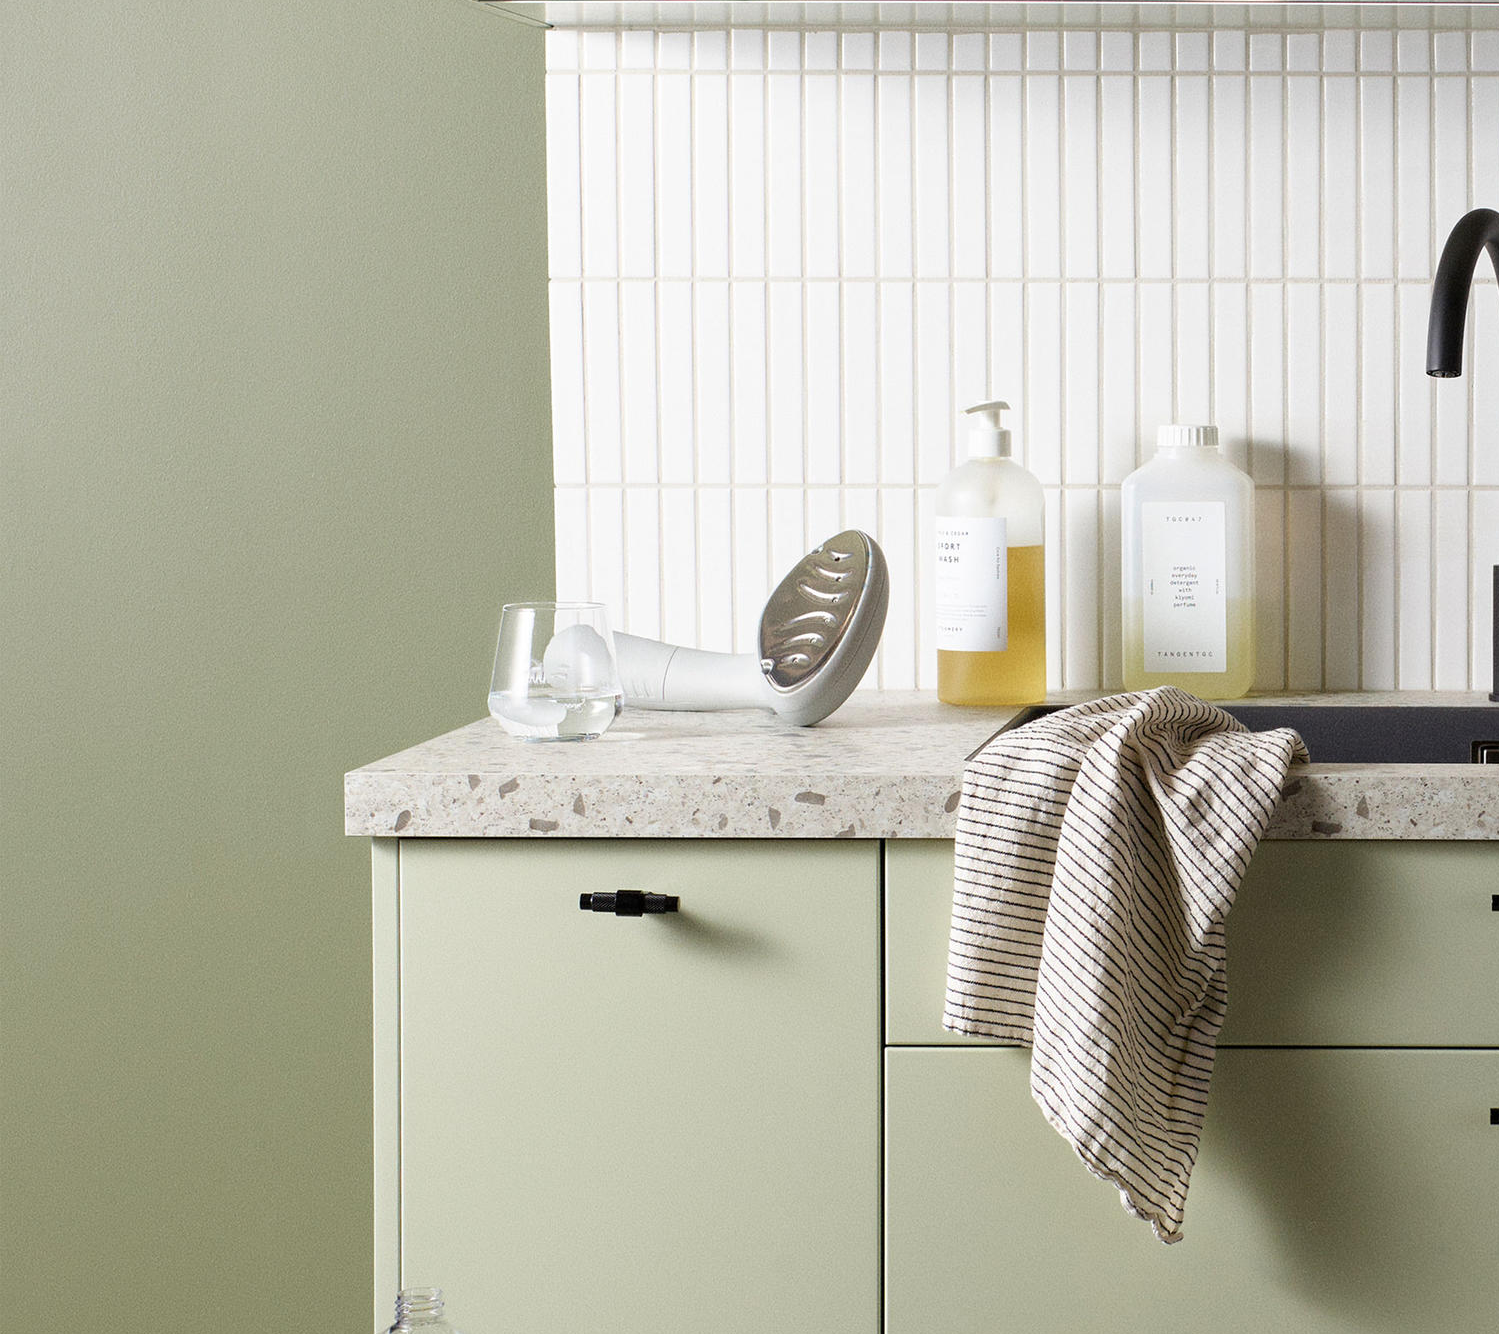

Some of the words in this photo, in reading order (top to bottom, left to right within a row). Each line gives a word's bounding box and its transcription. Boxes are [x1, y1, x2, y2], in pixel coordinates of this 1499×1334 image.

[1172, 565, 1197, 573] organic
[1170, 572, 1198, 580] everyday
[1169, 579, 1200, 588] detergent
[1172, 601, 1197, 609] perfume
